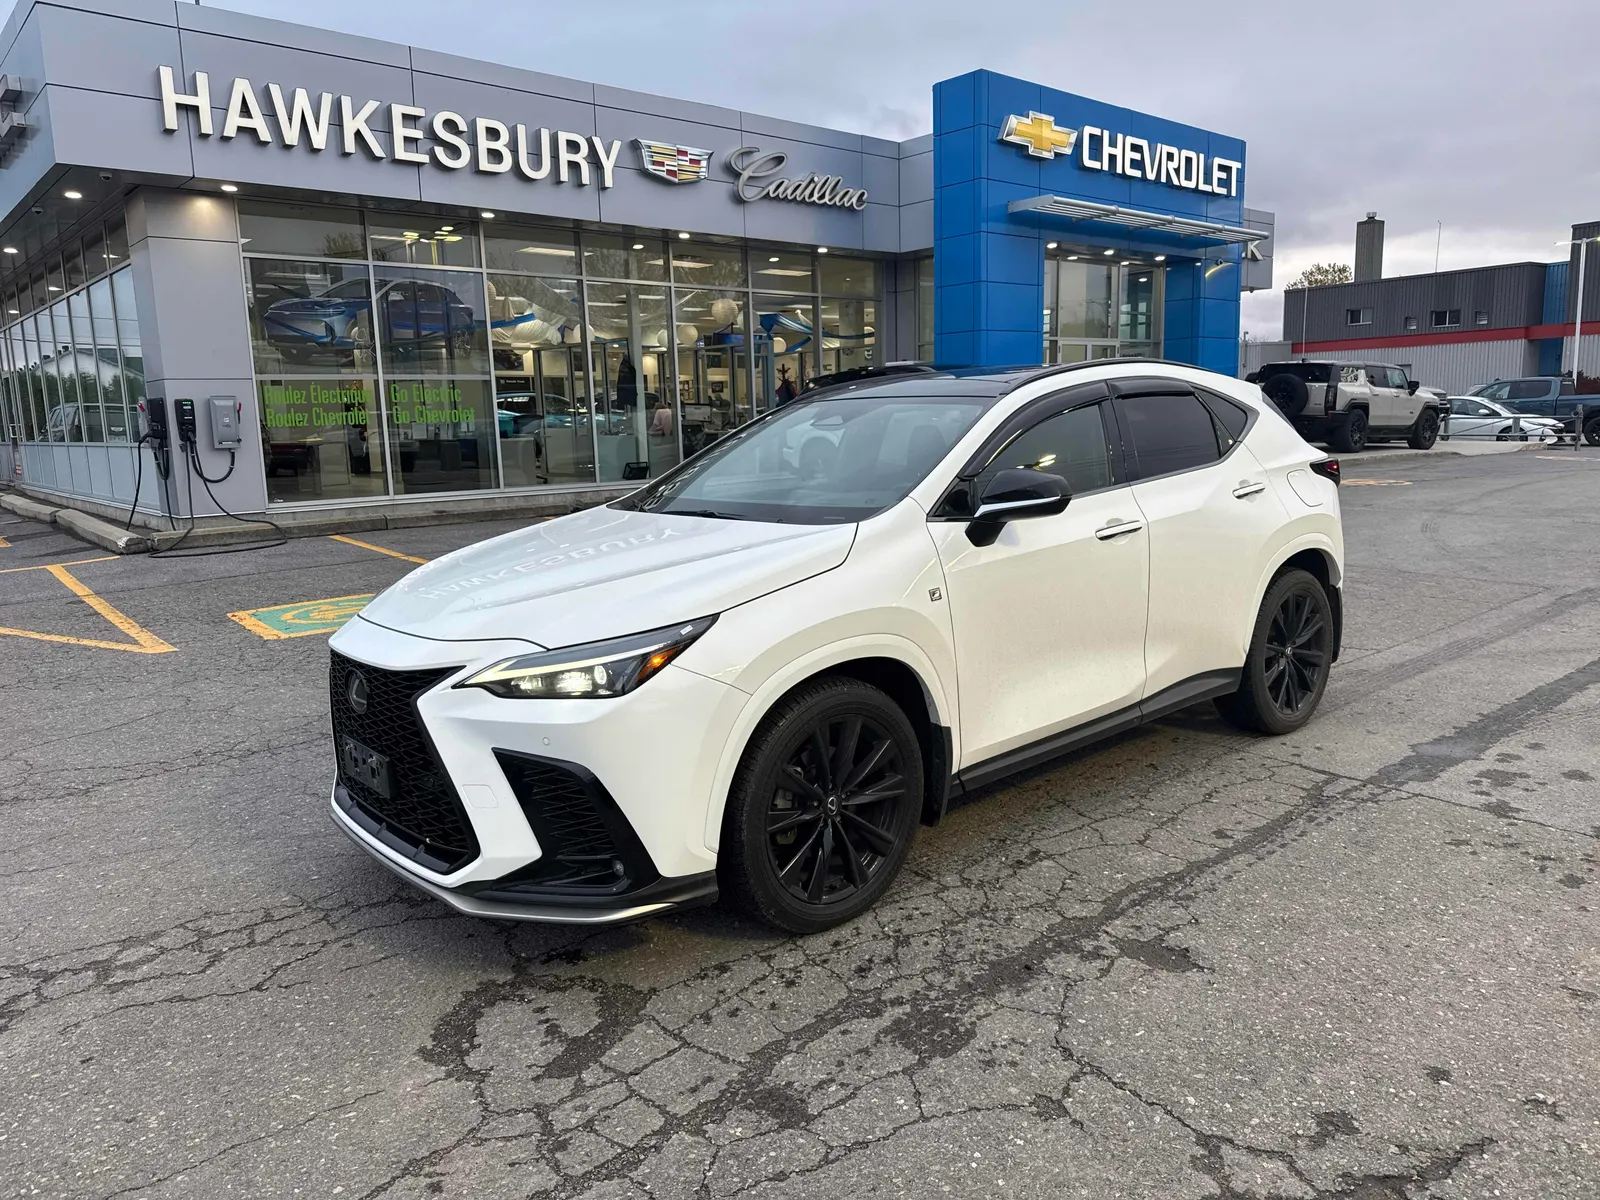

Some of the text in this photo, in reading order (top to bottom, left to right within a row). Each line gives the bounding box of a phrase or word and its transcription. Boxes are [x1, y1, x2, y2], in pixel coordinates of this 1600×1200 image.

[157, 65, 622, 190] HAWKESBURY
[1081, 125, 1242, 198] CHEVROLET
[727, 146, 868, 211] Cadillac
[264, 385, 307, 405] Roulez
[390, 383, 462, 403] Go Electric
[265, 407, 371, 428] Roulez Chevrolet
[392, 405, 475, 424] Go Chevrolet
